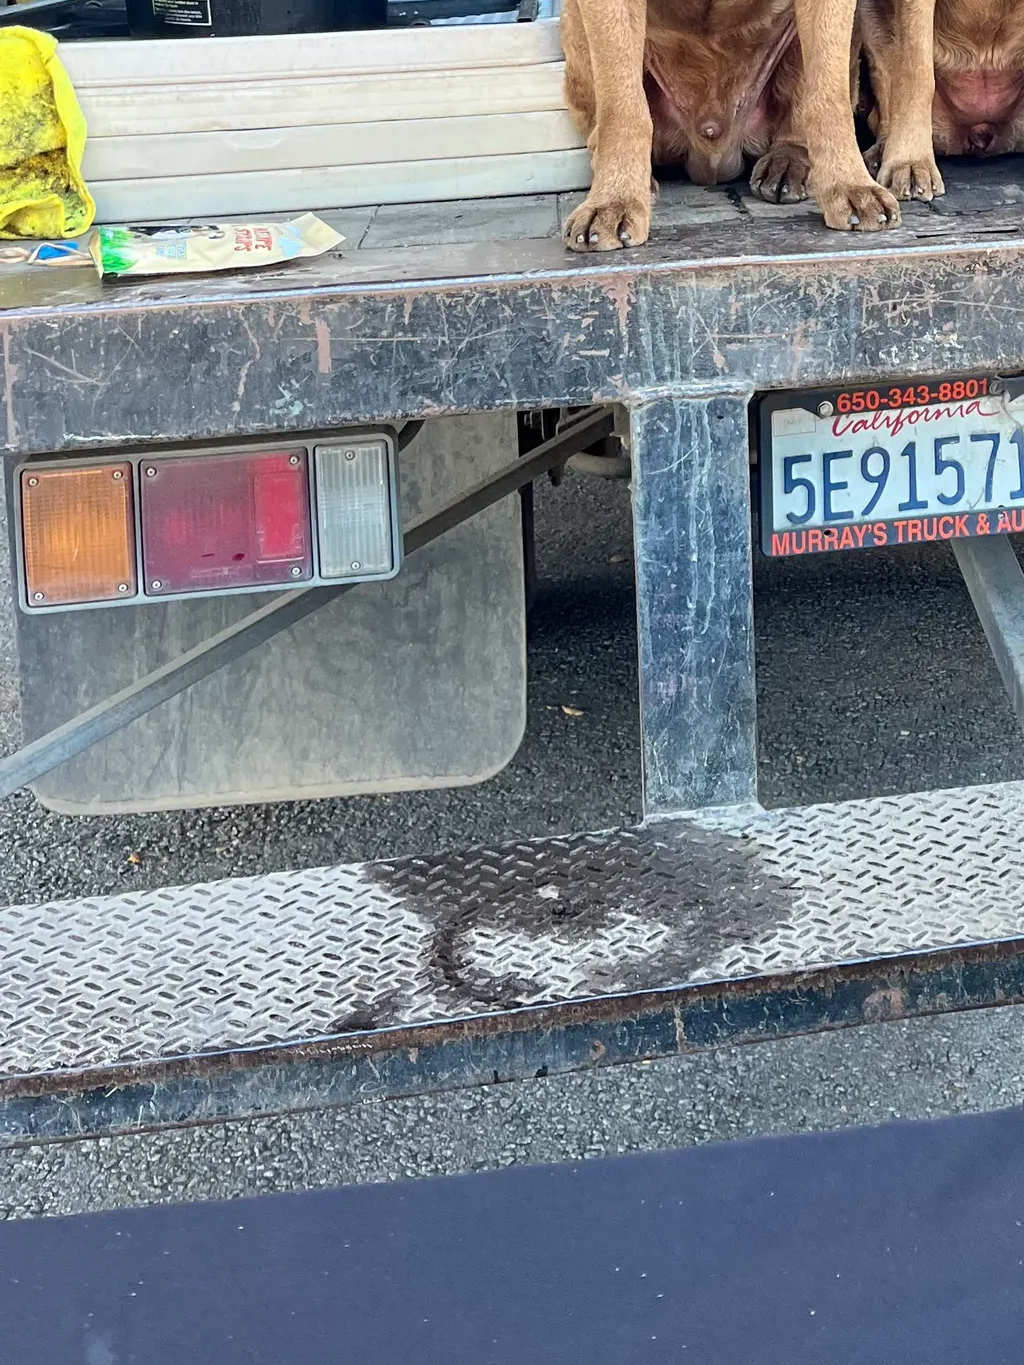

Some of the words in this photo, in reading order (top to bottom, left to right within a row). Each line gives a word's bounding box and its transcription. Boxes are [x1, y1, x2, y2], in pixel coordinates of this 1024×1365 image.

[836, 378, 989, 413] 650-343-8801
[831, 400, 1000, 437] California
[771, 522, 888, 557] MURRAY'S
[893, 514, 969, 544] TRUCK
[976, 513, 991, 535] &
